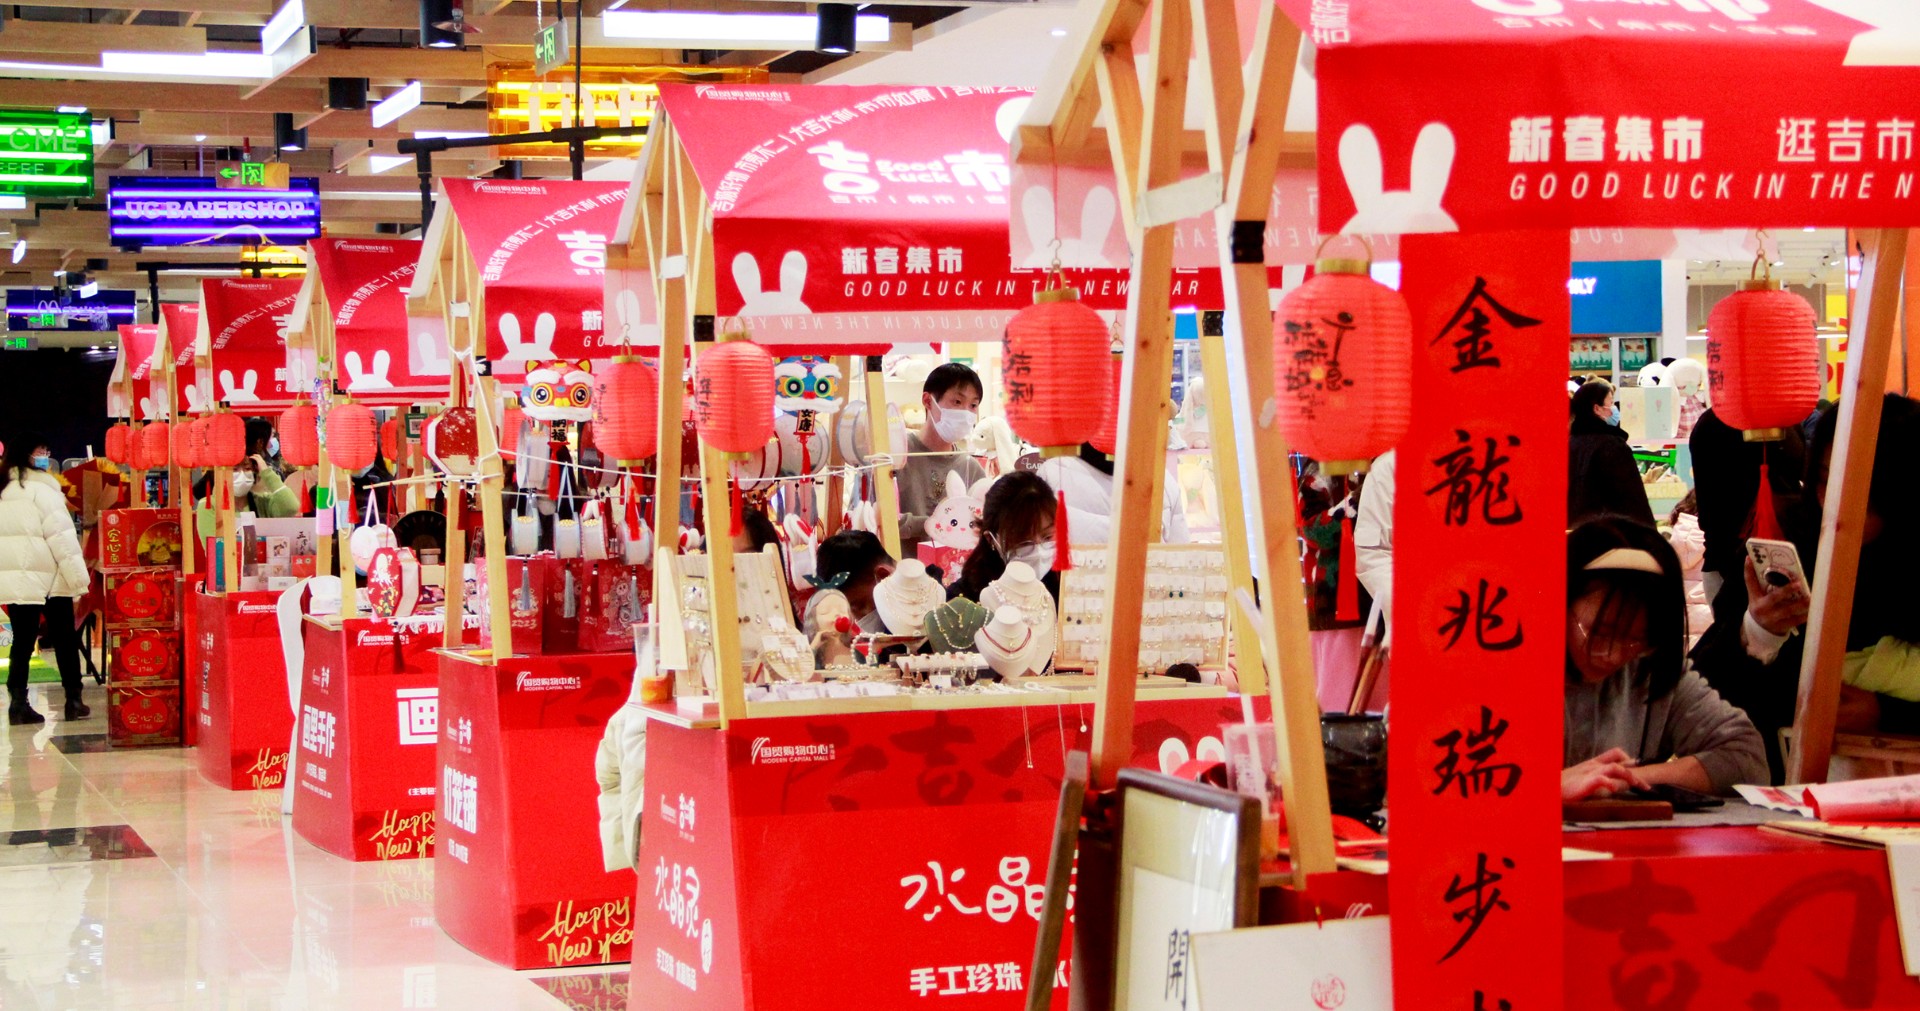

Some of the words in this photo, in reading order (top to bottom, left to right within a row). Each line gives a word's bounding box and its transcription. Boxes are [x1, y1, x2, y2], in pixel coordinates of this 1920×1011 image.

[1508, 117, 1703, 163] 新春集市
[1776, 117, 1916, 162] 逛吉市
[1510, 173, 1620, 200] GOOD
[1643, 172, 1735, 200] LUCK
[1753, 172, 1788, 200] IN
[1810, 171, 1875, 200] THE
[841, 246, 962, 275] 新春集市
[844, 280, 908, 297] GOOD
[922, 280, 982, 297] LUCK
[995, 280, 1016, 296] IN
[537, 896, 631, 942] Happy
[547, 935, 593, 967] New
[909, 961, 1023, 997] 手工珍珠
